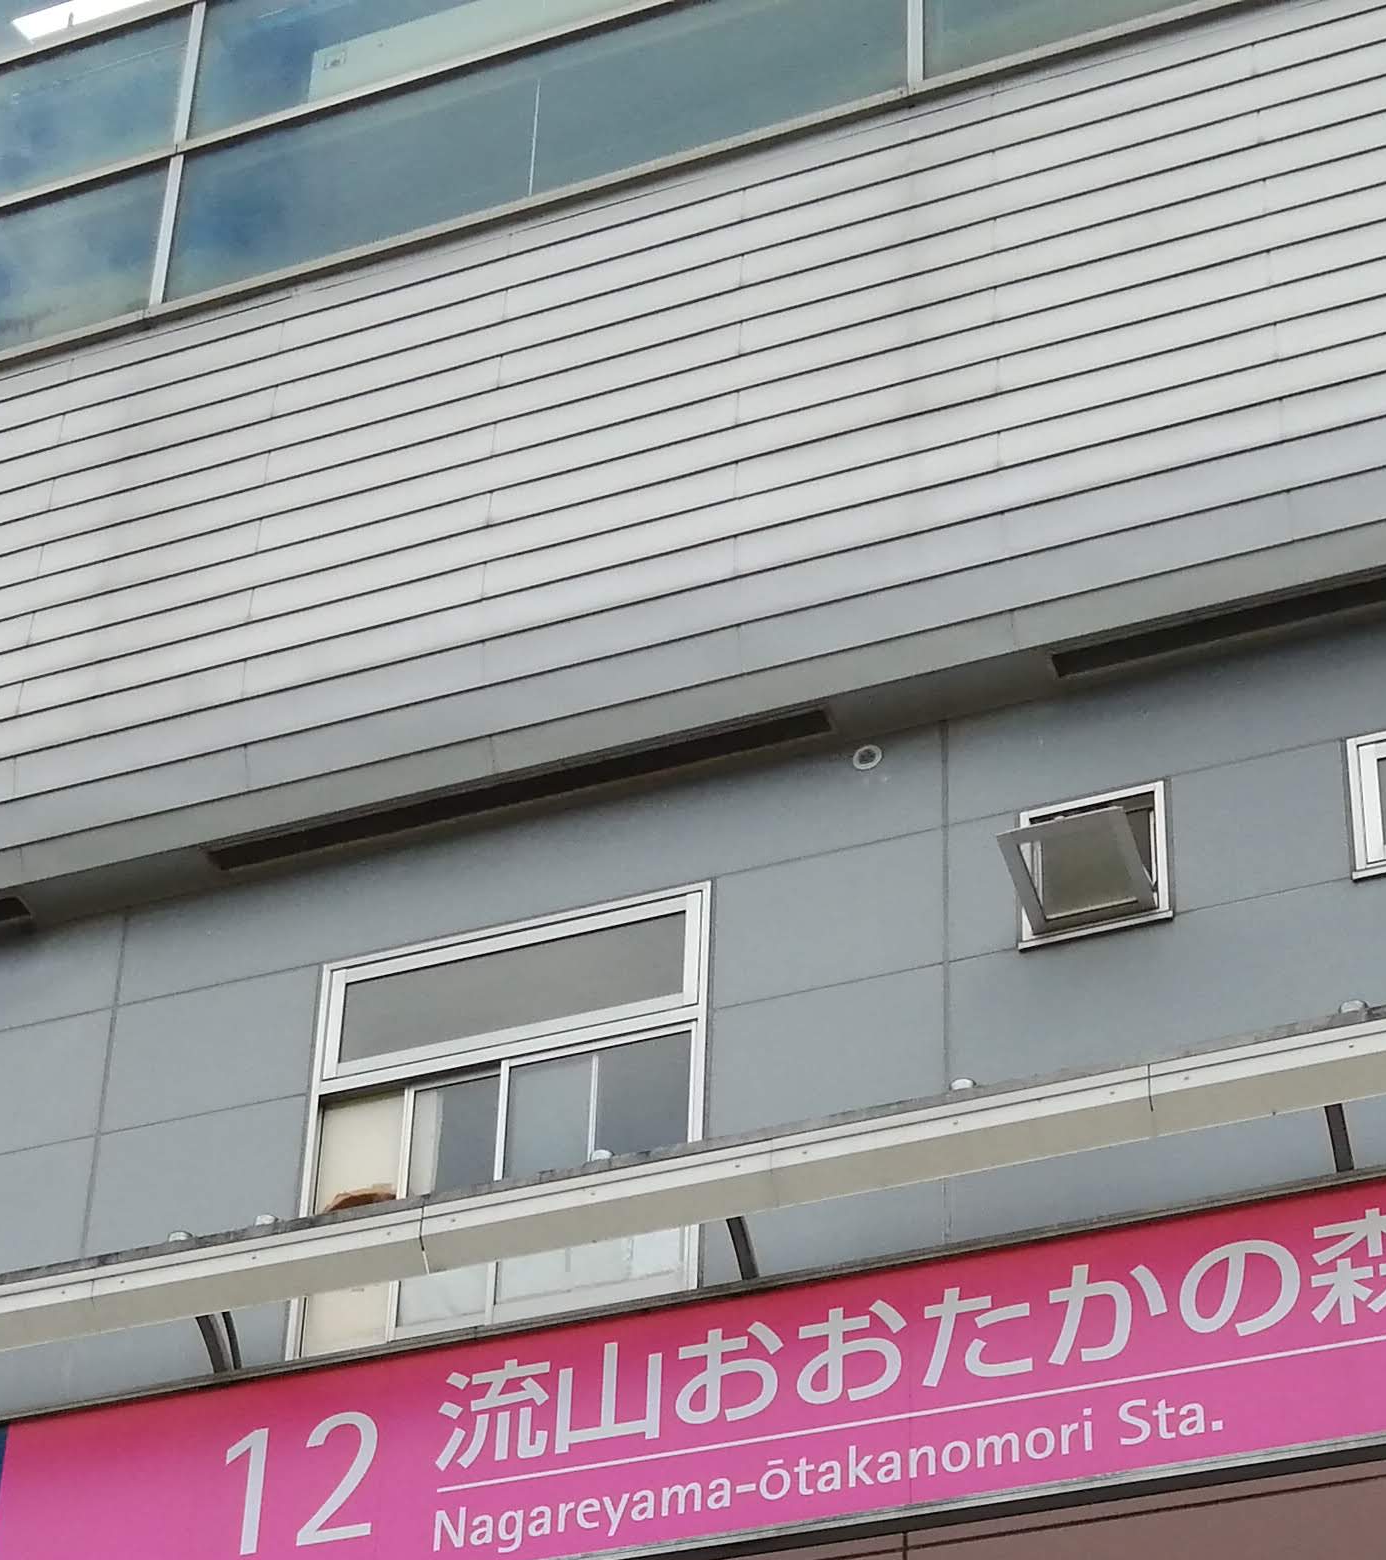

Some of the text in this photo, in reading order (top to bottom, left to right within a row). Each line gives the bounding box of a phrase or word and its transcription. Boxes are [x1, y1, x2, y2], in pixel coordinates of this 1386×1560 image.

[224, 1411, 379, 1556] 12
[432, 1398, 1224, 1555] Nagareyama-ōtakanomori Sta.
